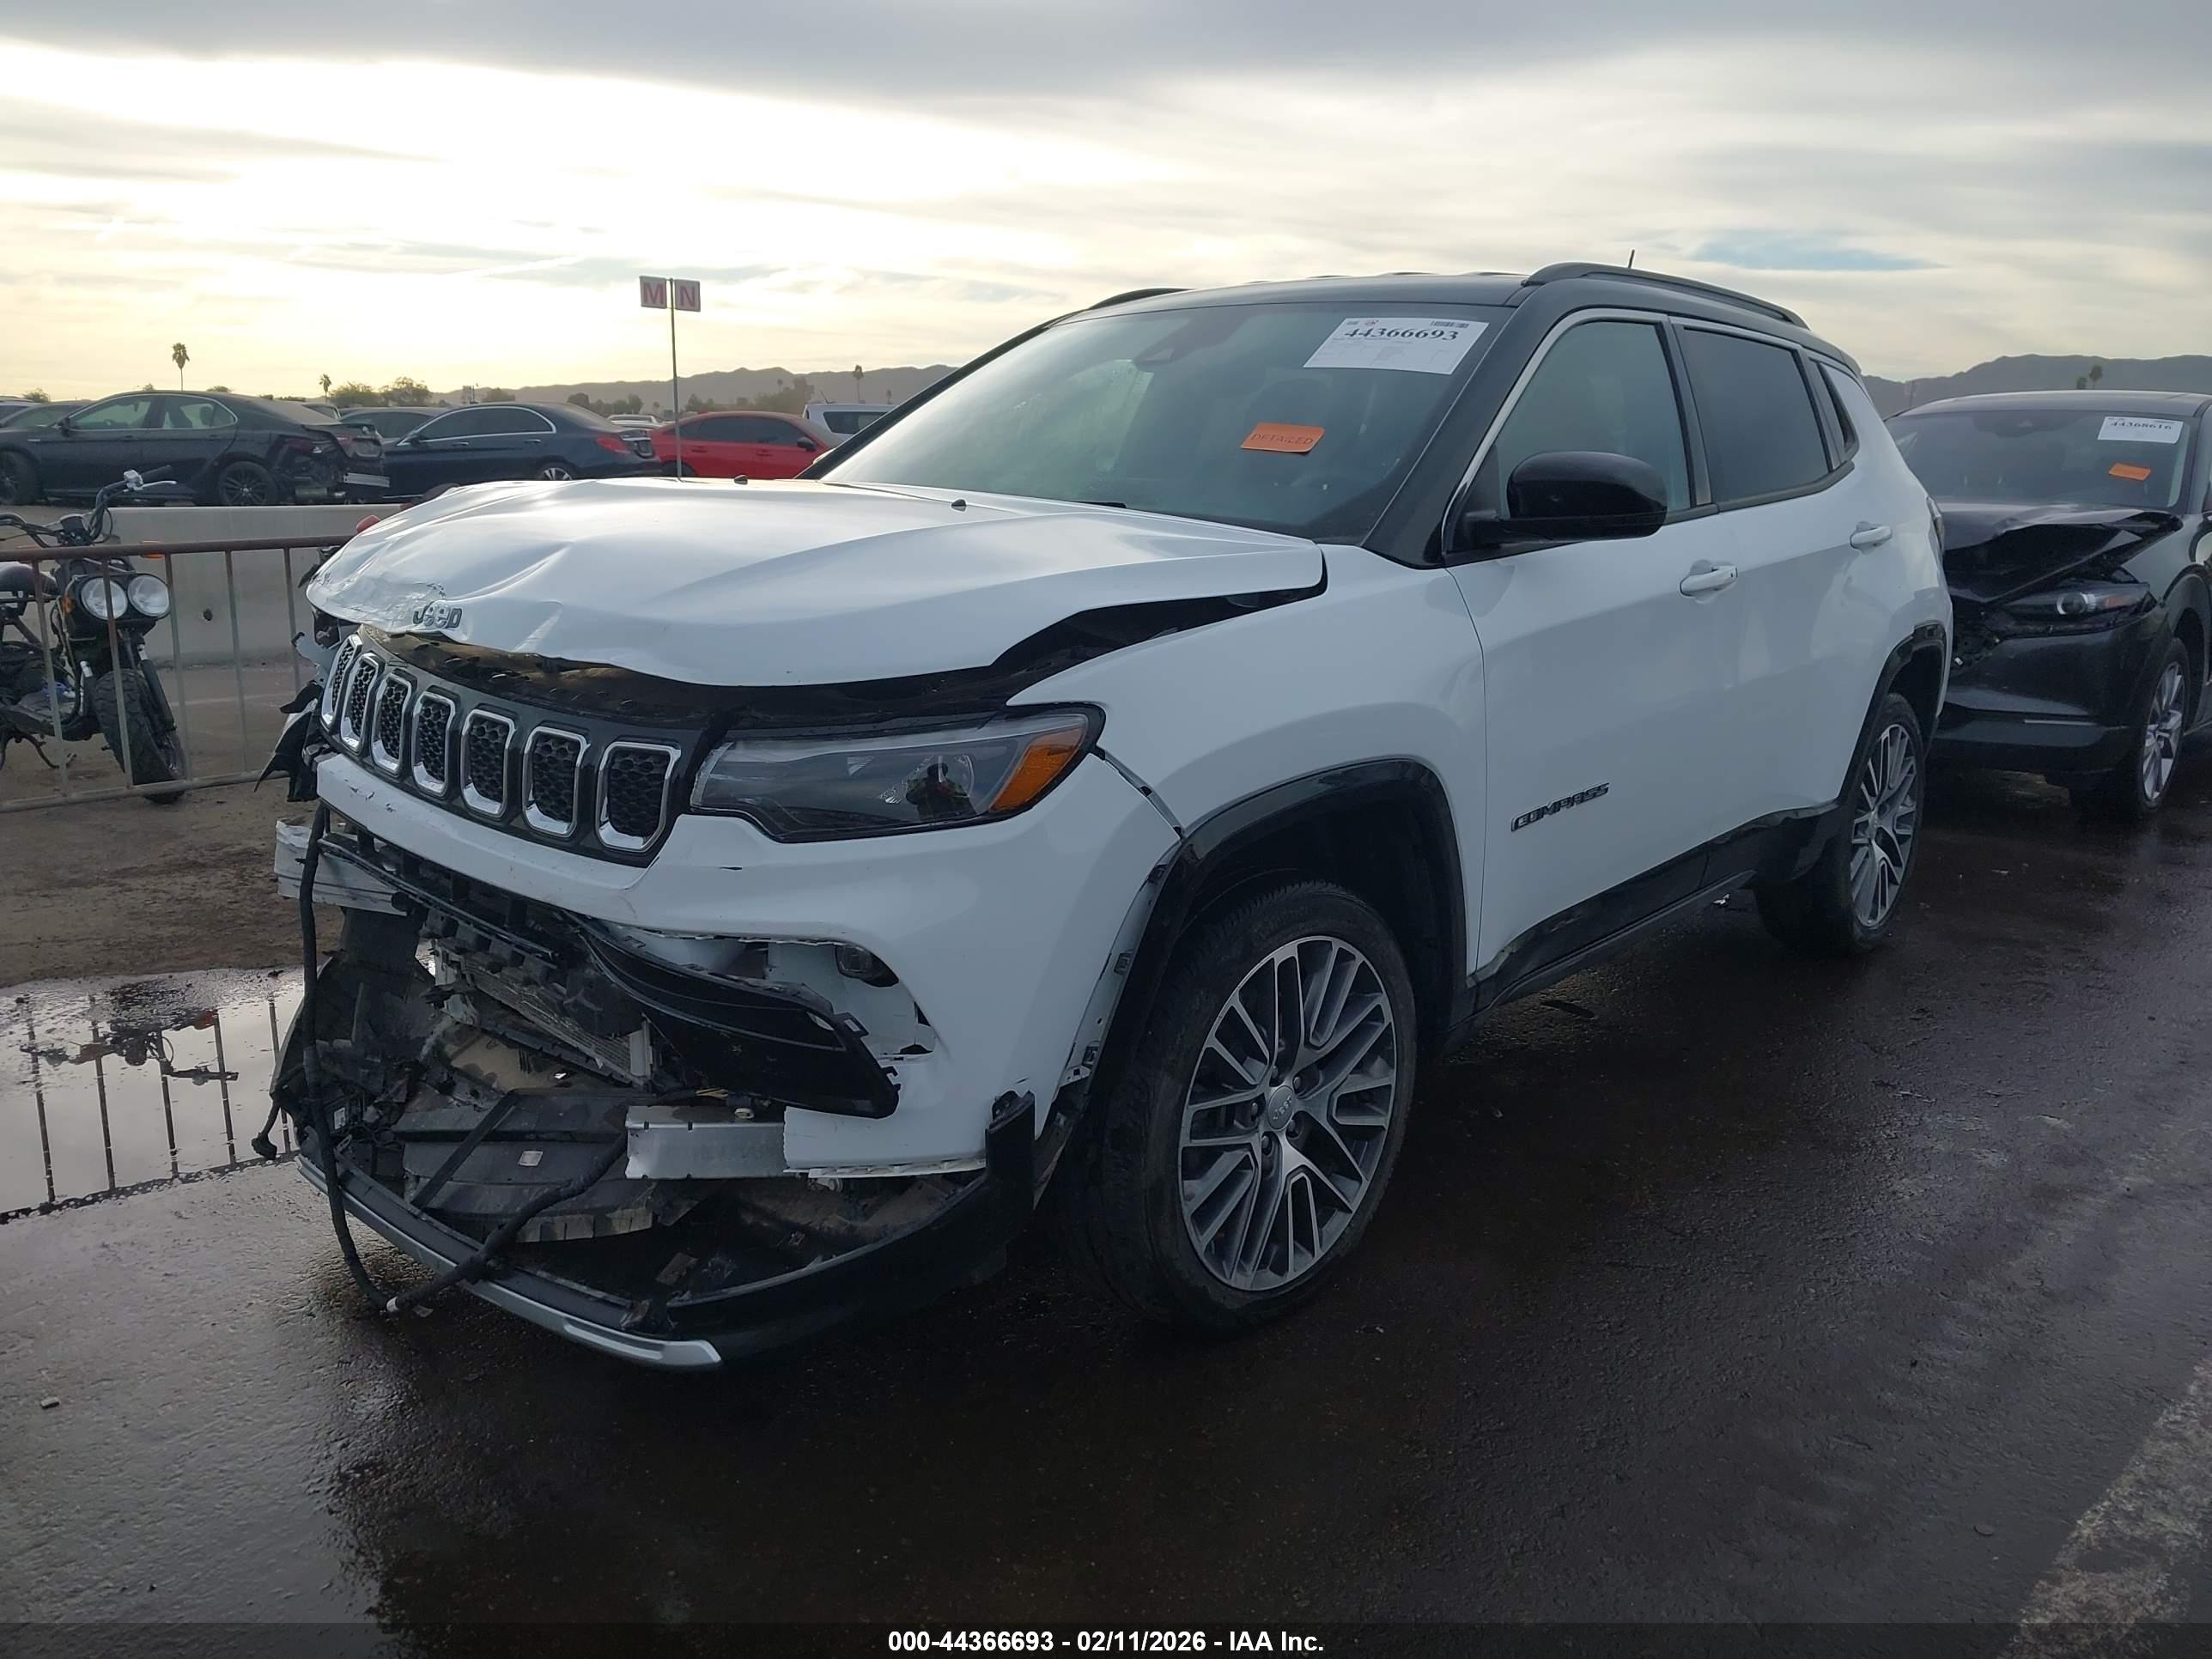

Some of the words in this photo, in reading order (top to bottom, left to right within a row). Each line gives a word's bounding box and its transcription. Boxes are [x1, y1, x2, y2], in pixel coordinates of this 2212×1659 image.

[642, 282, 665, 306] M
[679, 285, 696, 307] N
[1344, 328, 1460, 341] 44366693
[1510, 781, 1610, 832] COMPASS
